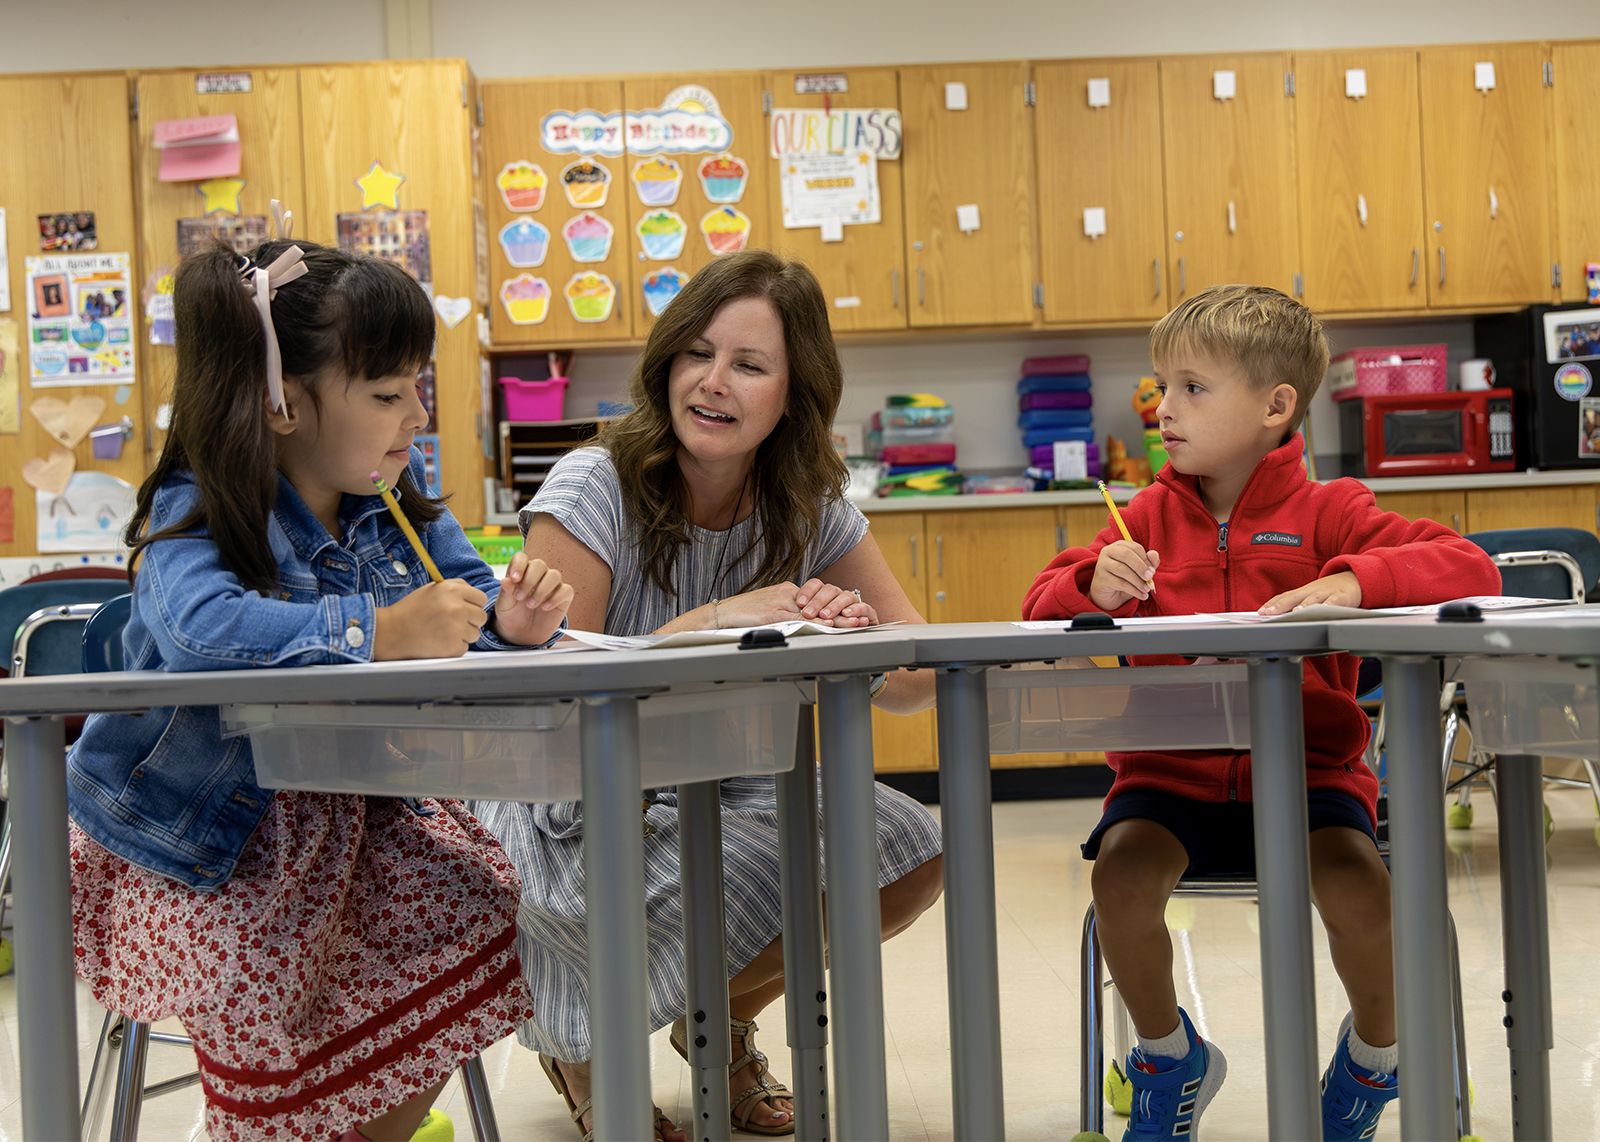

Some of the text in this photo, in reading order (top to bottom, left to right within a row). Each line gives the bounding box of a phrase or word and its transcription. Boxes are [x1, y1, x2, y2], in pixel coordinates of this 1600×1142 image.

[553, 124, 719, 142] Happy Birthday
[773, 109, 902, 156] OUR CLASS
[1263, 533, 1298, 544] Columbia
